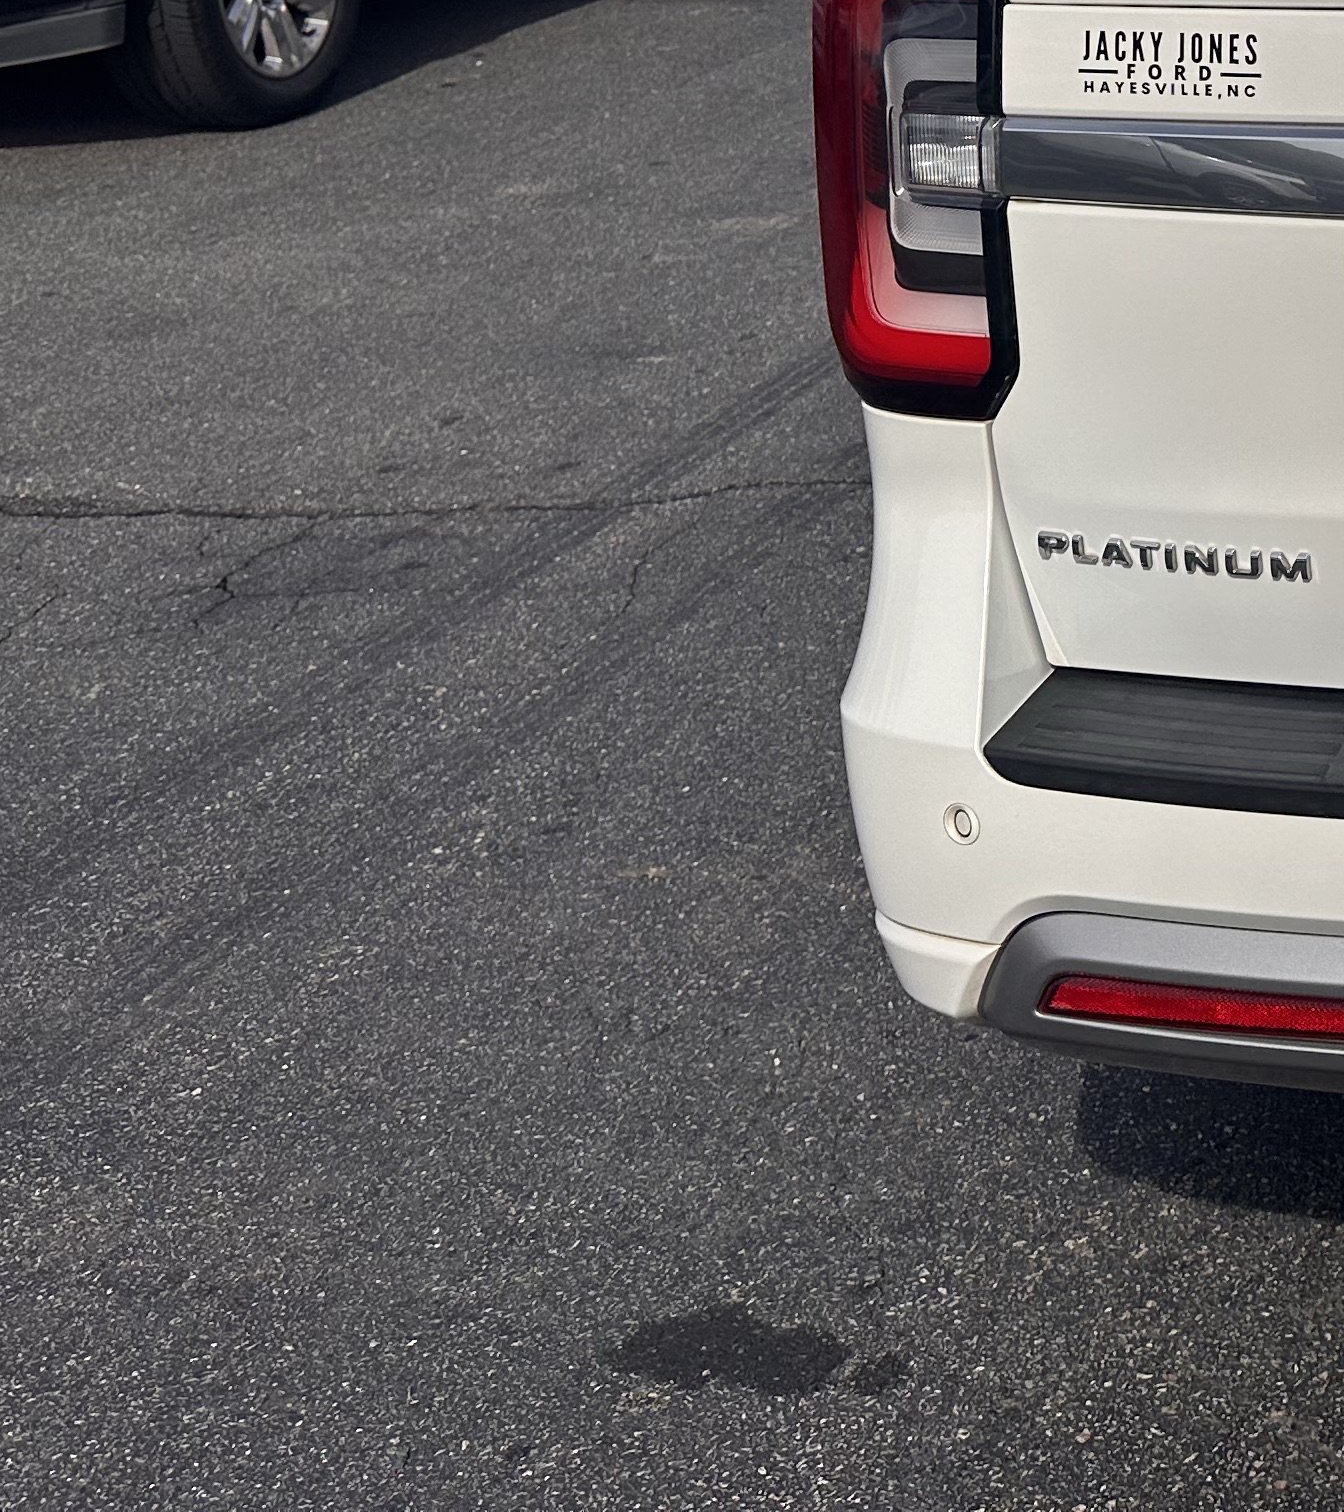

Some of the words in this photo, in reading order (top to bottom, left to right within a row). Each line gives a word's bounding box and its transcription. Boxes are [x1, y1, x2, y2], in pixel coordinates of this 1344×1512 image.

[1083, 30, 1163, 62] JACKY
[1177, 33, 1258, 65] JONES
[1127, 63, 1212, 81] FORD
[1037, 530, 1313, 583] PLATINUM
